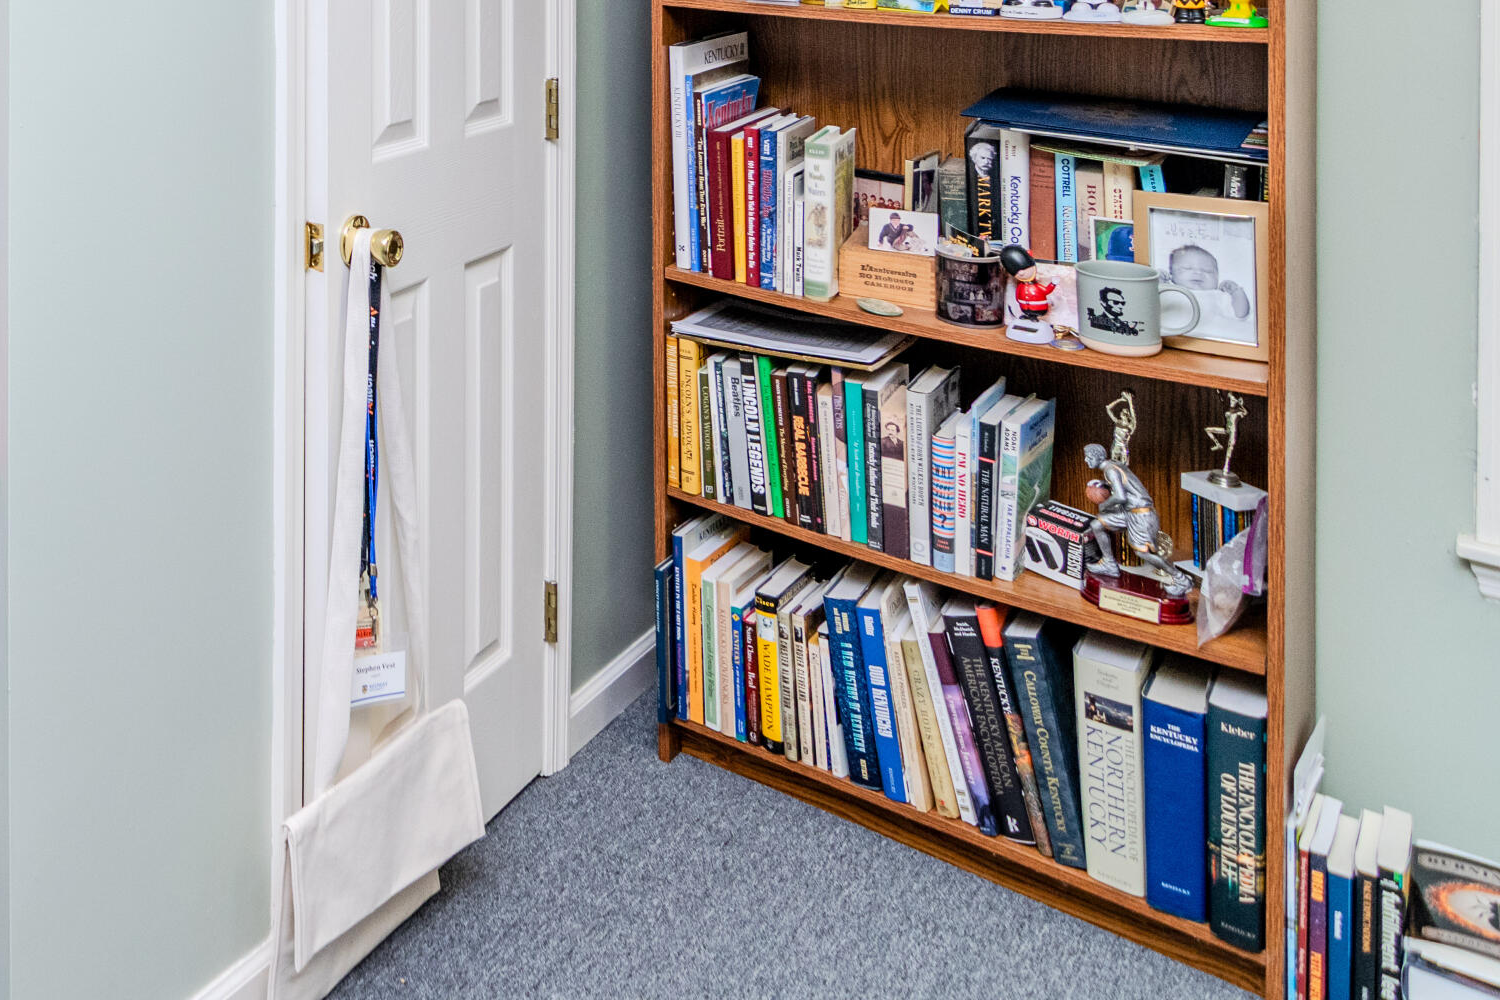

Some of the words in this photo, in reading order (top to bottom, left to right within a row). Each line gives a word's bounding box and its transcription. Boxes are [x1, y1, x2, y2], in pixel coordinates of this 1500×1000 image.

[950, 7, 972, 15] DENNY
[973, 8, 993, 16] CRUM
[704, 43, 740, 65] KENTUCKY
[1061, 158, 1071, 197] COTTRELL
[977, 176, 991, 218] MARK
[1007, 176, 1021, 225] Kentucky
[716, 218, 726, 252] Portrait
[730, 377, 742, 417] Beatles
[684, 418, 693, 461] ADVOCATE
[741, 375, 760, 432] LINCOLN
[751, 434, 765, 494] LEGENDS
[793, 415, 805, 440] REAL
[867, 442, 877, 465] Kentucky
[958, 452, 966, 468] I'M
[781, 464, 789, 491] Everything
[794, 442, 810, 496] BARBECUE
[869, 467, 878, 486] Authors
[958, 472, 966, 487] NO
[981, 469, 989, 485] THE
[870, 488, 878, 496] and
[870, 497, 879, 510] Their
[958, 489, 966, 518] HERO
[981, 487, 990, 522] NATURAL
[870, 512, 880, 528] Books
[1038, 518, 1080, 542] WORTH
[980, 524, 989, 544] MAN
[1004, 519, 1012, 559] APPALACHIA
[763, 643, 771, 670] WADE
[780, 640, 789, 667] CHESTER
[795, 644, 804, 668] GROVER
[842, 650, 853, 667] NEW
[356, 664, 381, 674] Stephen
[381, 662, 396, 670] Vest
[721, 657, 729, 705] GOVERNORS
[748, 672, 756, 688] Real
[781, 668, 790, 685] ALAN
[868, 665, 885, 686] OUR
[972, 657, 986, 678] THE
[783, 686, 791, 709] ARTHUR
[797, 669, 807, 702] CLEVELAND
[844, 669, 857, 700] HISTORY
[913, 670, 926, 705] CRAZY
[764, 673, 773, 732] HAMPTON
[848, 701, 859, 712] OF
[872, 688, 893, 738] KENTUCKY
[978, 681, 998, 738] KENTUCKY
[850, 714, 866, 753] KENTUCKY
[961, 656, 981, 712] AMERICAN
[977, 715, 1004, 796] ENCYCLOPEDIA
[1150, 725, 1198, 745] KENTUCKY
[1220, 722, 1256, 741] Kleber
[1024, 671, 1042, 726] CALLOWAY
[1046, 777, 1066, 832] KENTUCKY
[1125, 738, 1135, 760] THE
[1150, 733, 1199, 752] ENCYCLOPEDIA
[994, 741, 1013, 788] AFRICAN
[1238, 762, 1255, 792] THE
[1086, 725, 1107, 850] KENTUCKY
[1105, 731, 1126, 858] NORTHERN
[1221, 773, 1237, 795] OF
[1126, 762, 1137, 845] ENCYCLOPEDIA
[1221, 797, 1237, 882] LOUISVILLE
[1238, 794, 1256, 904] ENCYCLOPEDIA
[1129, 847, 1138, 862] OF
